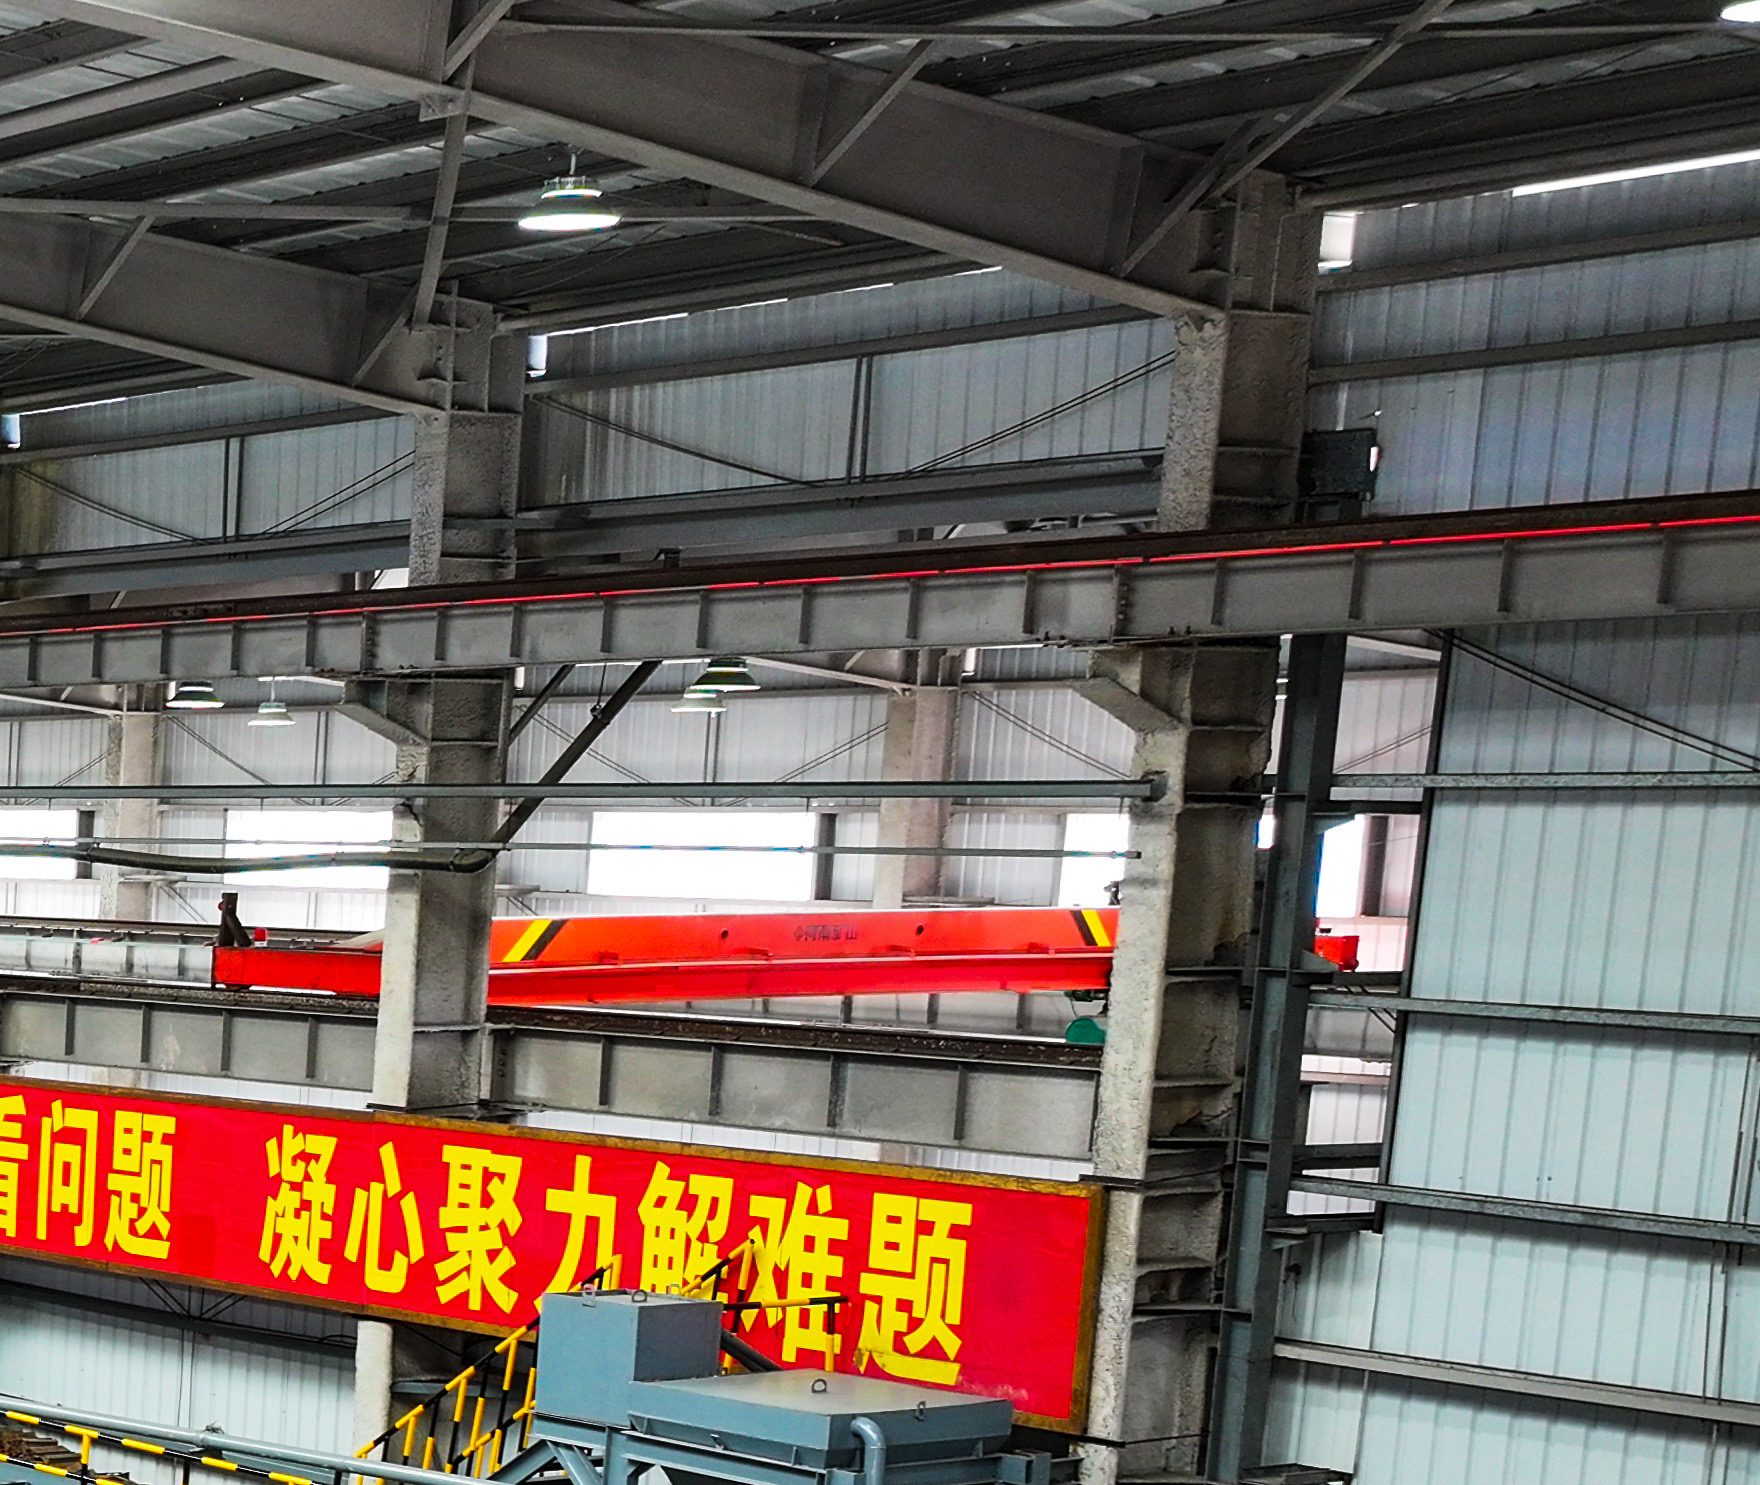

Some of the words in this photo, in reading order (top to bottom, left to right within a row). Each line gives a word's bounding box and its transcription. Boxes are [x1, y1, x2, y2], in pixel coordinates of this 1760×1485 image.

[259, 1123, 974, 1386] 凝心聚力解难题
